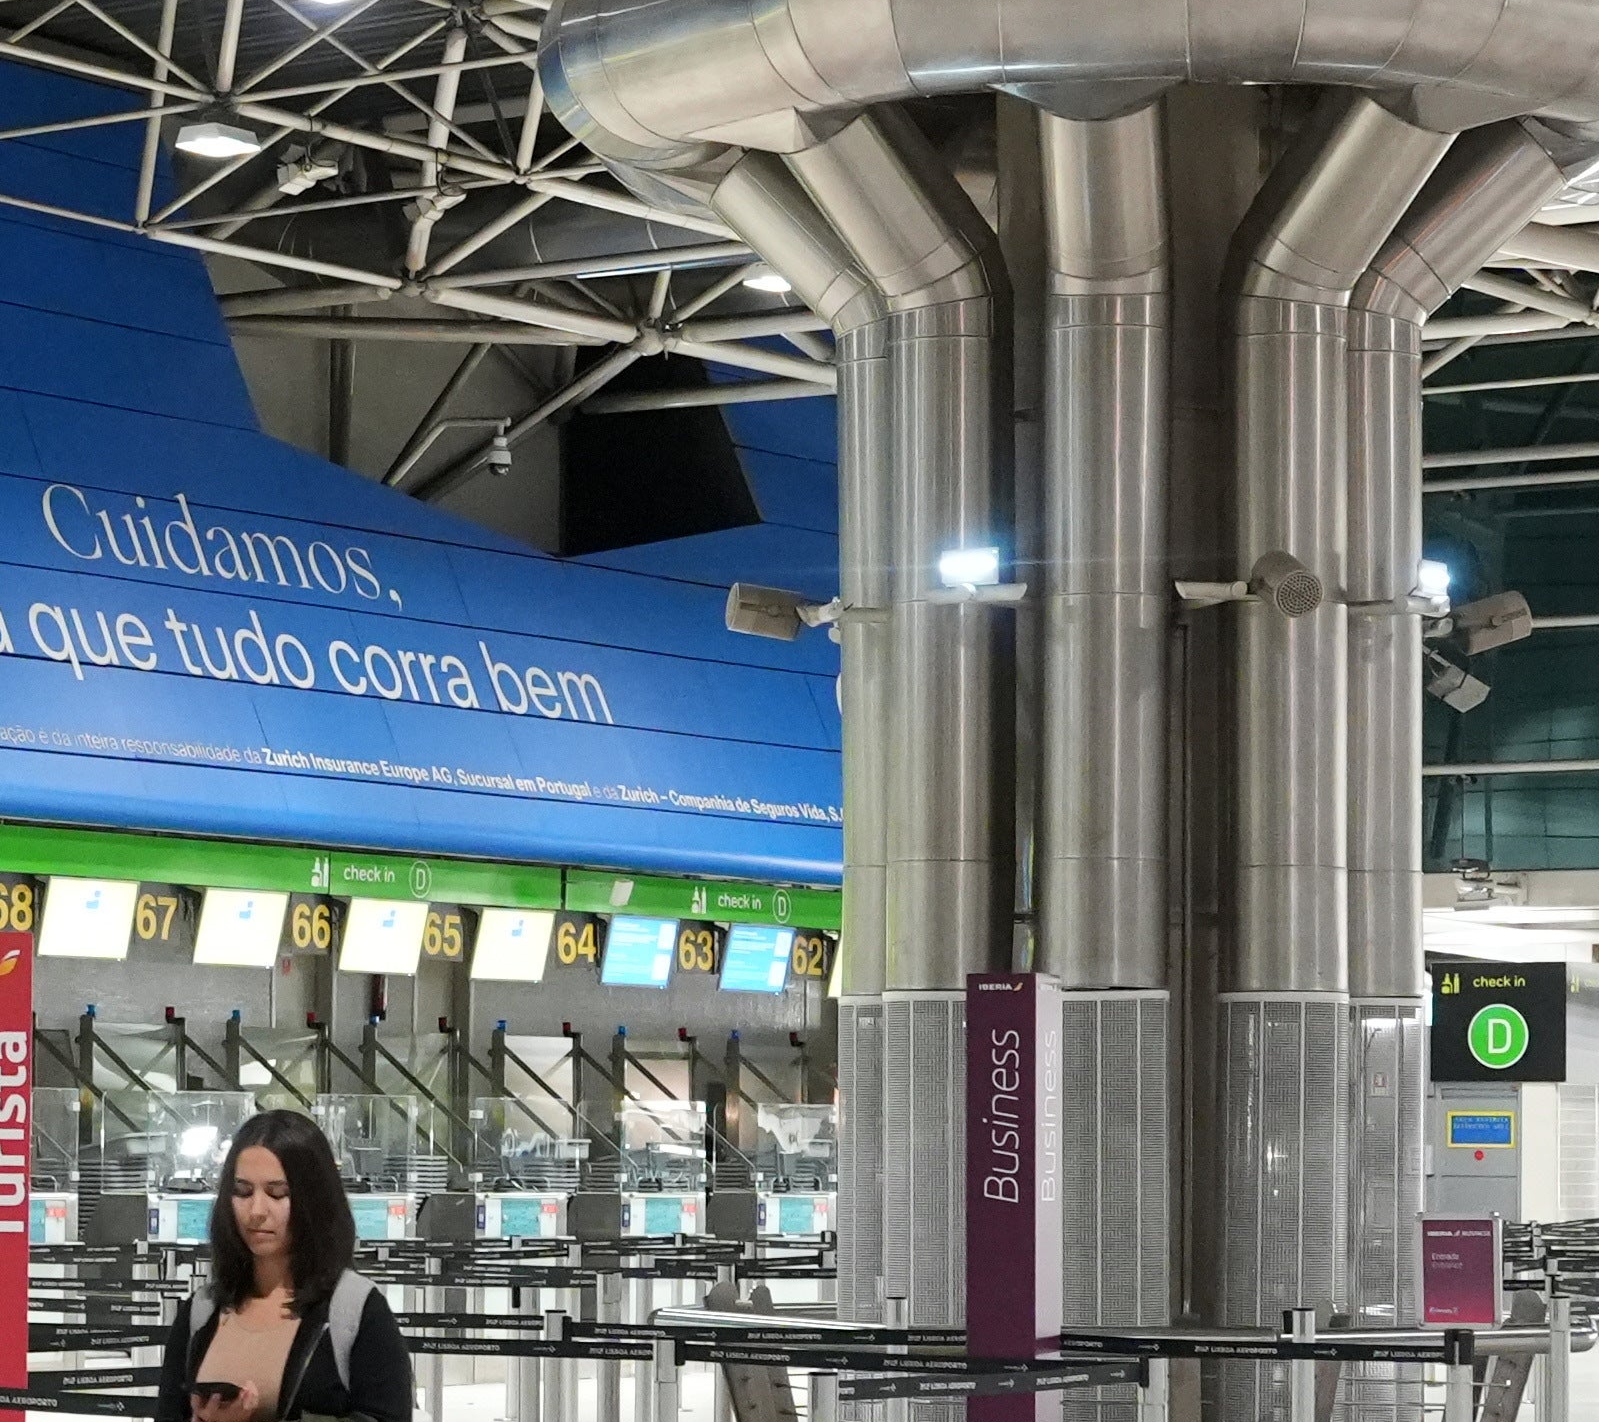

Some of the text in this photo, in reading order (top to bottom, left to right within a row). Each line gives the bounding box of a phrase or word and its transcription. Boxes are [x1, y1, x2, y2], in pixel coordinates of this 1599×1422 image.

[41, 483, 404, 610] Cuidamos,
[30, 606, 159, 681] que
[165, 607, 316, 691] tudo
[329, 640, 478, 707] corra
[481, 641, 615, 725] bem
[261, 747, 309, 770] Zurich
[310, 753, 380, 777] Insurance
[381, 761, 430, 784] Europe
[432, 766, 456, 785] AG,
[457, 769, 514, 791] Sucursal
[515, 777, 535, 793] em
[537, 776, 590, 800] Portugal
[618, 784, 659, 805] Zurich
[668, 790, 734, 813] Companhia
[735, 798, 751, 814] de
[751, 798, 799, 822] Seguros
[799, 802, 830, 822] Vida,
[343, 864, 427, 890] check in D
[136, 893, 179, 941] 67
[292, 904, 331, 949] 66
[717, 893, 787, 917] check in D
[424, 912, 462, 957] 65
[557, 922, 597, 966] 64
[679, 929, 714, 972] 63
[792, 935, 823, 975] 62
[979, 983, 1013, 991] IBERIA
[1473, 975, 1526, 988] check in
[1487, 1018, 1512, 1054] D
[982, 1028, 1020, 1204] Business
[1041, 1030, 1057, 1202] Business
